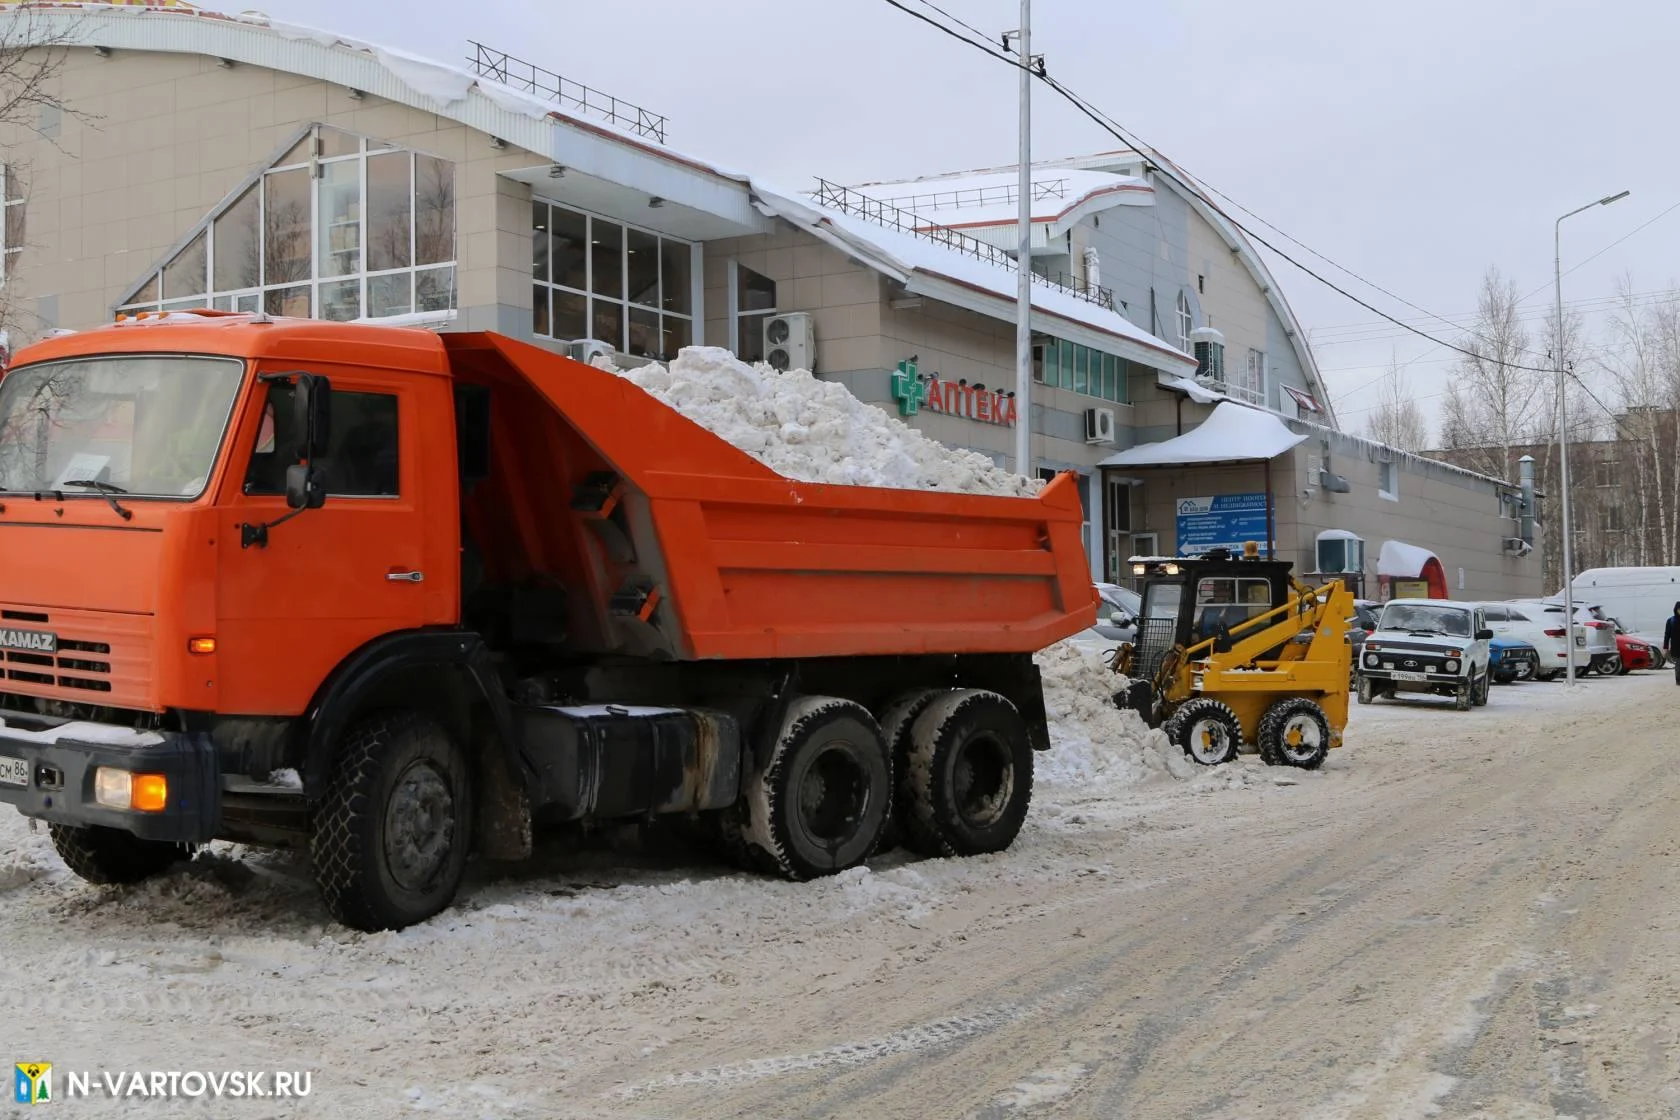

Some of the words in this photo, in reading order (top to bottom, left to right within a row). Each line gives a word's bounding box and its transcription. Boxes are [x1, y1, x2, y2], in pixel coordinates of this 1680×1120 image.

[928, 377, 1017, 425] АПТЕКА
[0, 629, 53, 651] KAMAZ
[15, 761, 25, 776] 86
